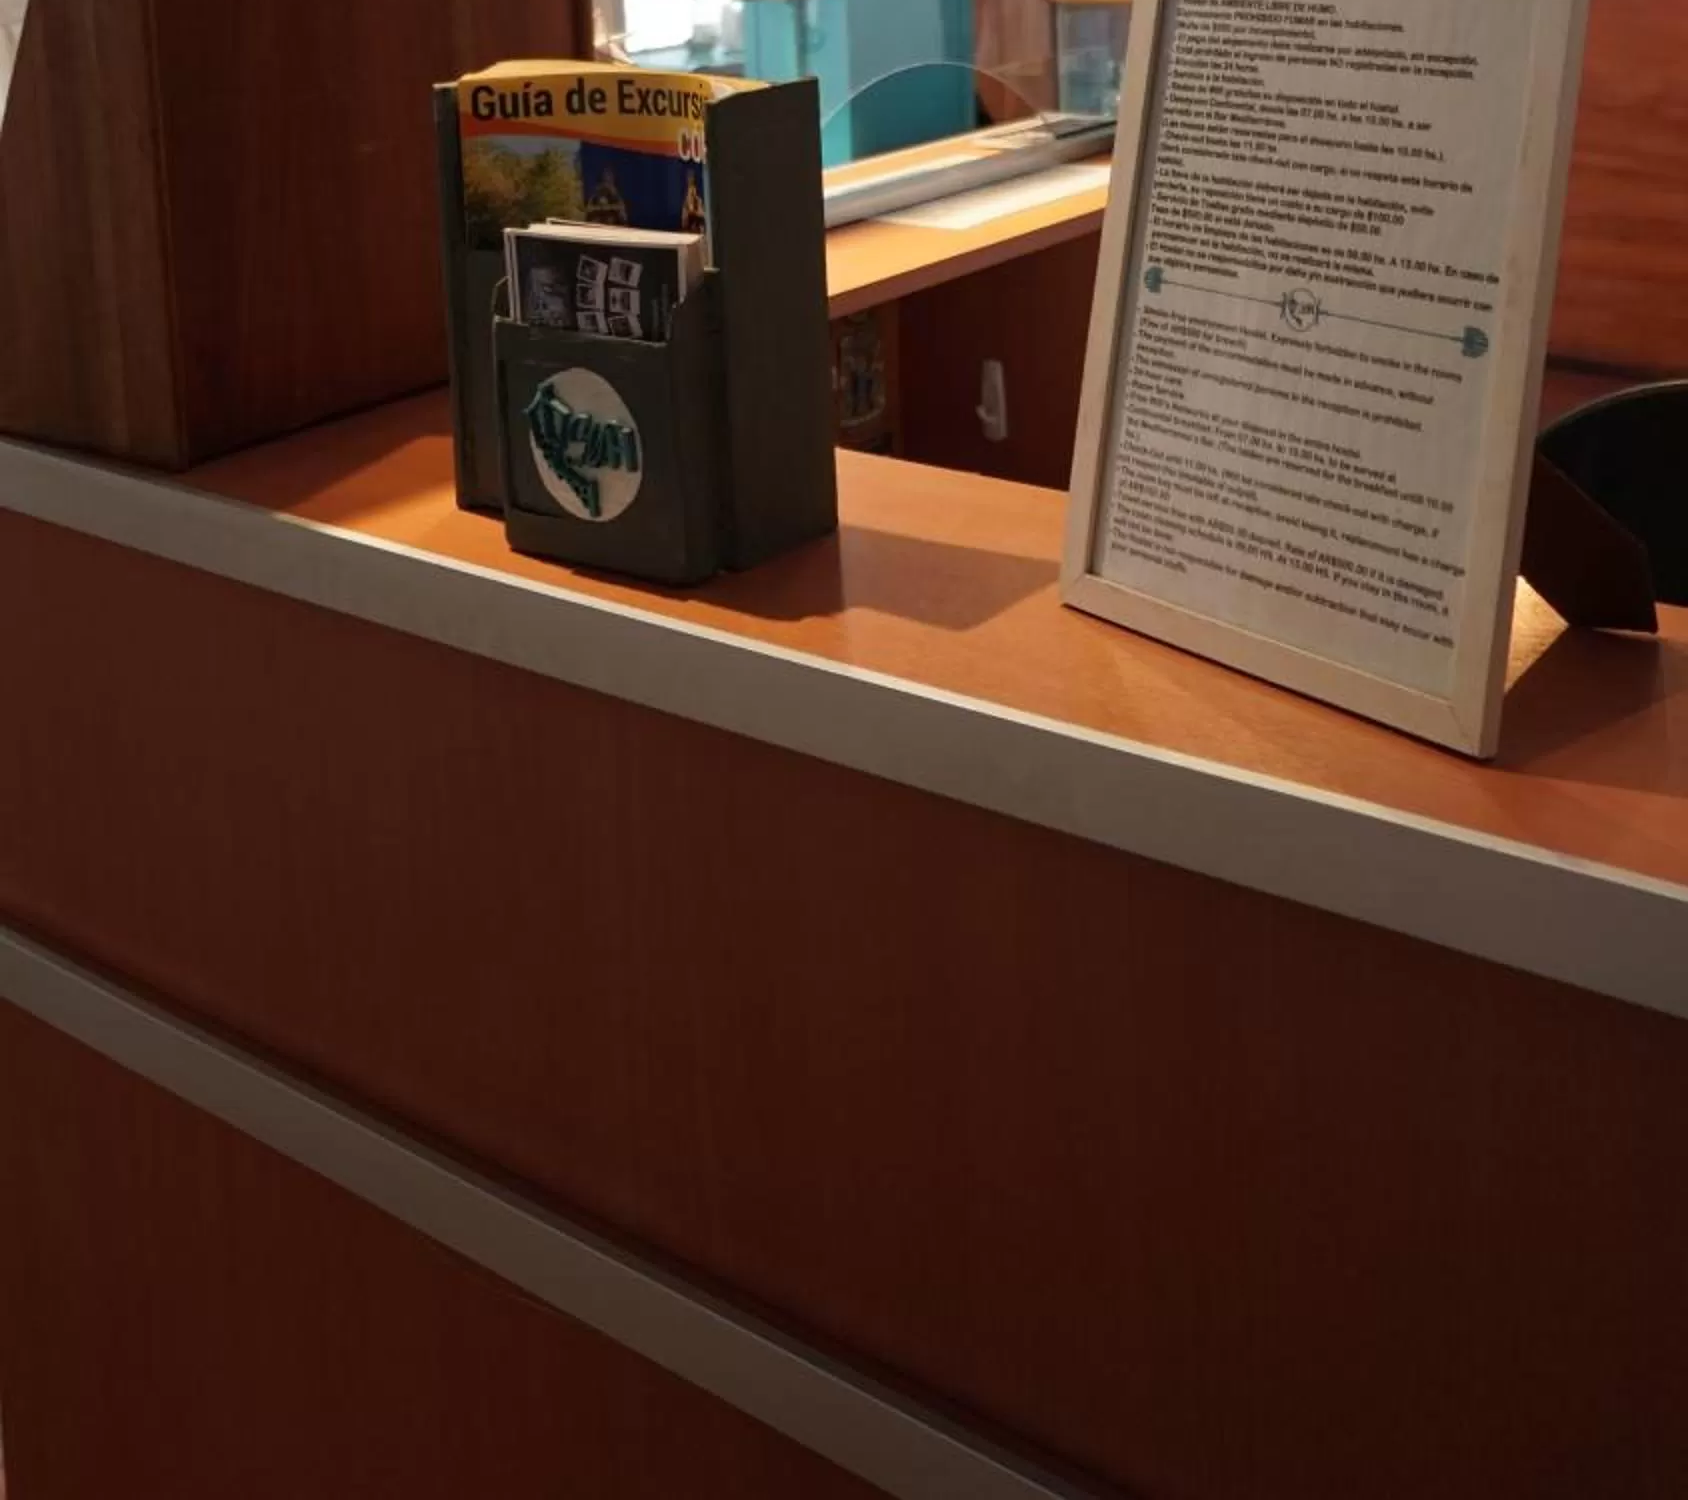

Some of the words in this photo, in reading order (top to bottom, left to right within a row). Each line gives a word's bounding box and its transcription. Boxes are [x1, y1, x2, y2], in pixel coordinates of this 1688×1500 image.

[471, 80, 553, 121] Guía
[566, 77, 607, 115] de
[617, 79, 707, 120] Excursi
